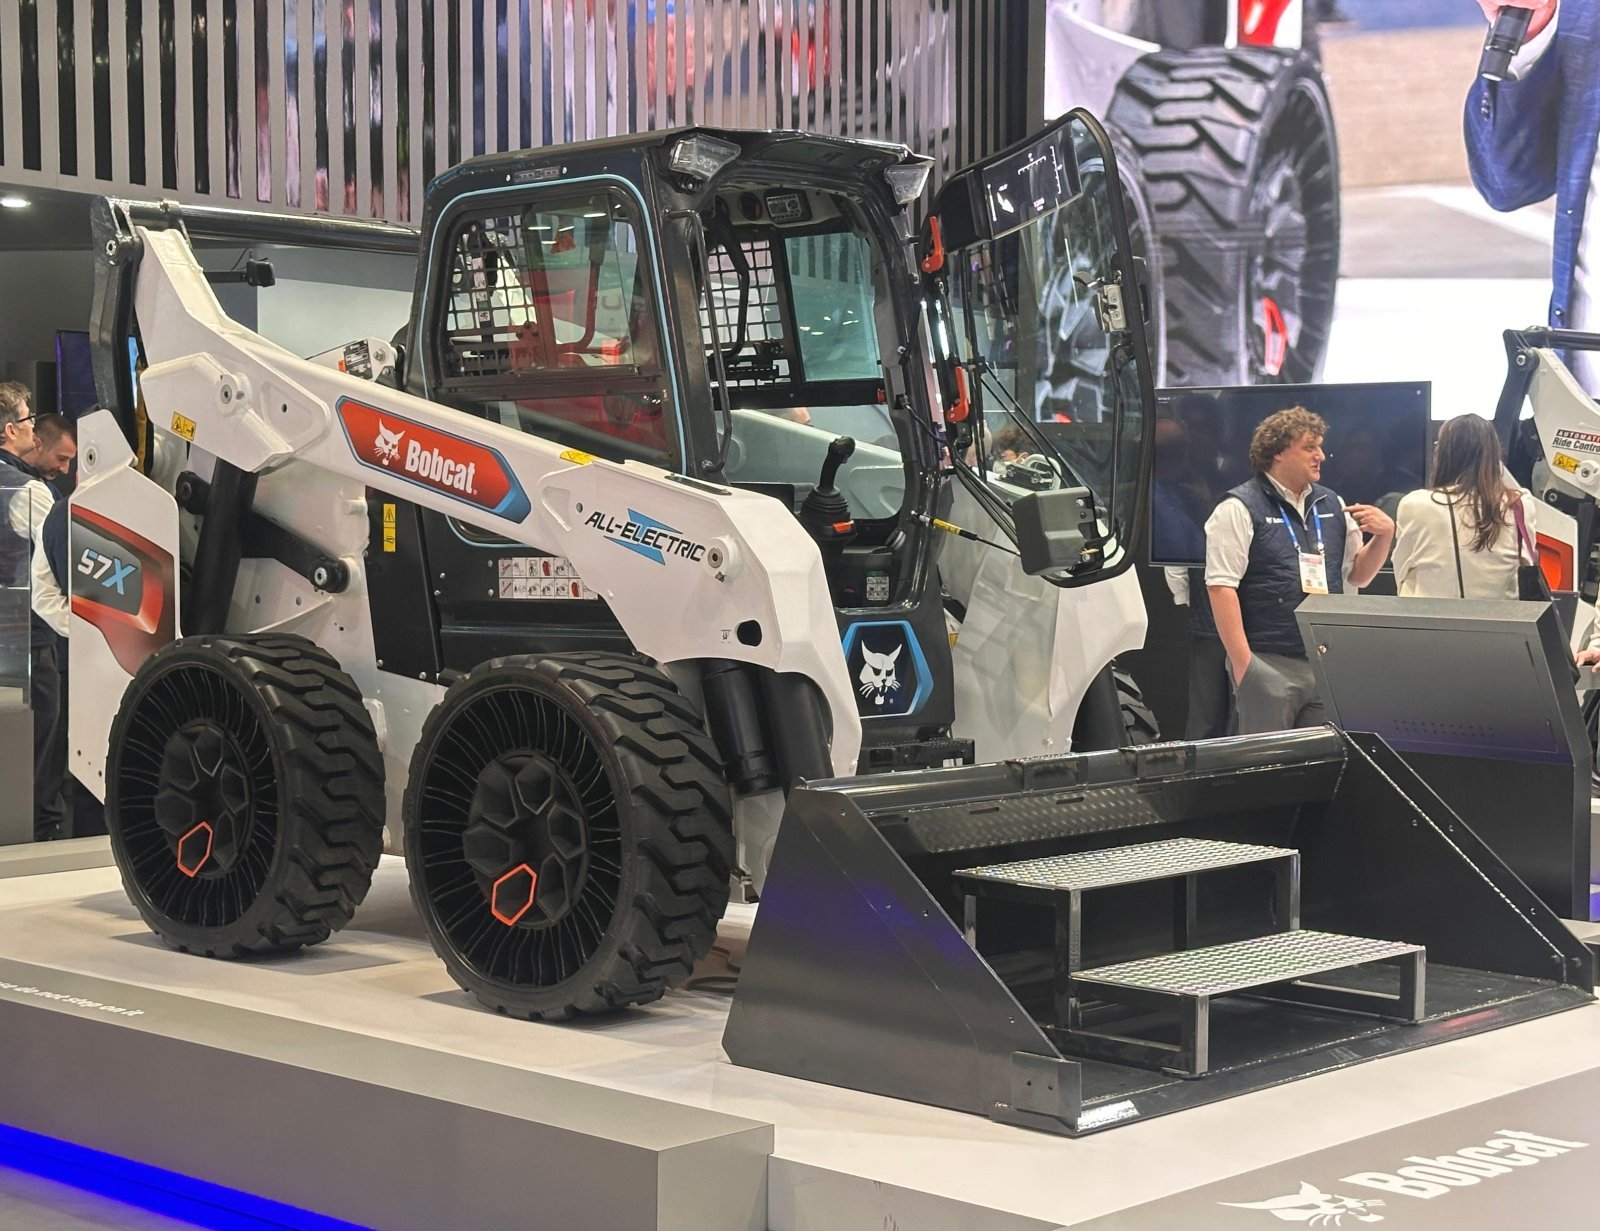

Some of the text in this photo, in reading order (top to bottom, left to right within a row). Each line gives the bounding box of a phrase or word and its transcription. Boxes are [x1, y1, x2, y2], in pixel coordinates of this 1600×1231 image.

[405, 439, 474, 494] Bobcat
[1552, 437, 1572, 447] Ride
[584, 511, 706, 562] ALL-ELECTRIC
[77, 548, 137, 595] S7X
[13, 986, 40, 994] do
[34, 991, 71, 1000] not
[62, 997, 103, 1008] step
[99, 1005, 127, 1013] on
[120, 1009, 145, 1017] it
[1338, 1129, 1590, 1200] Bobcat
